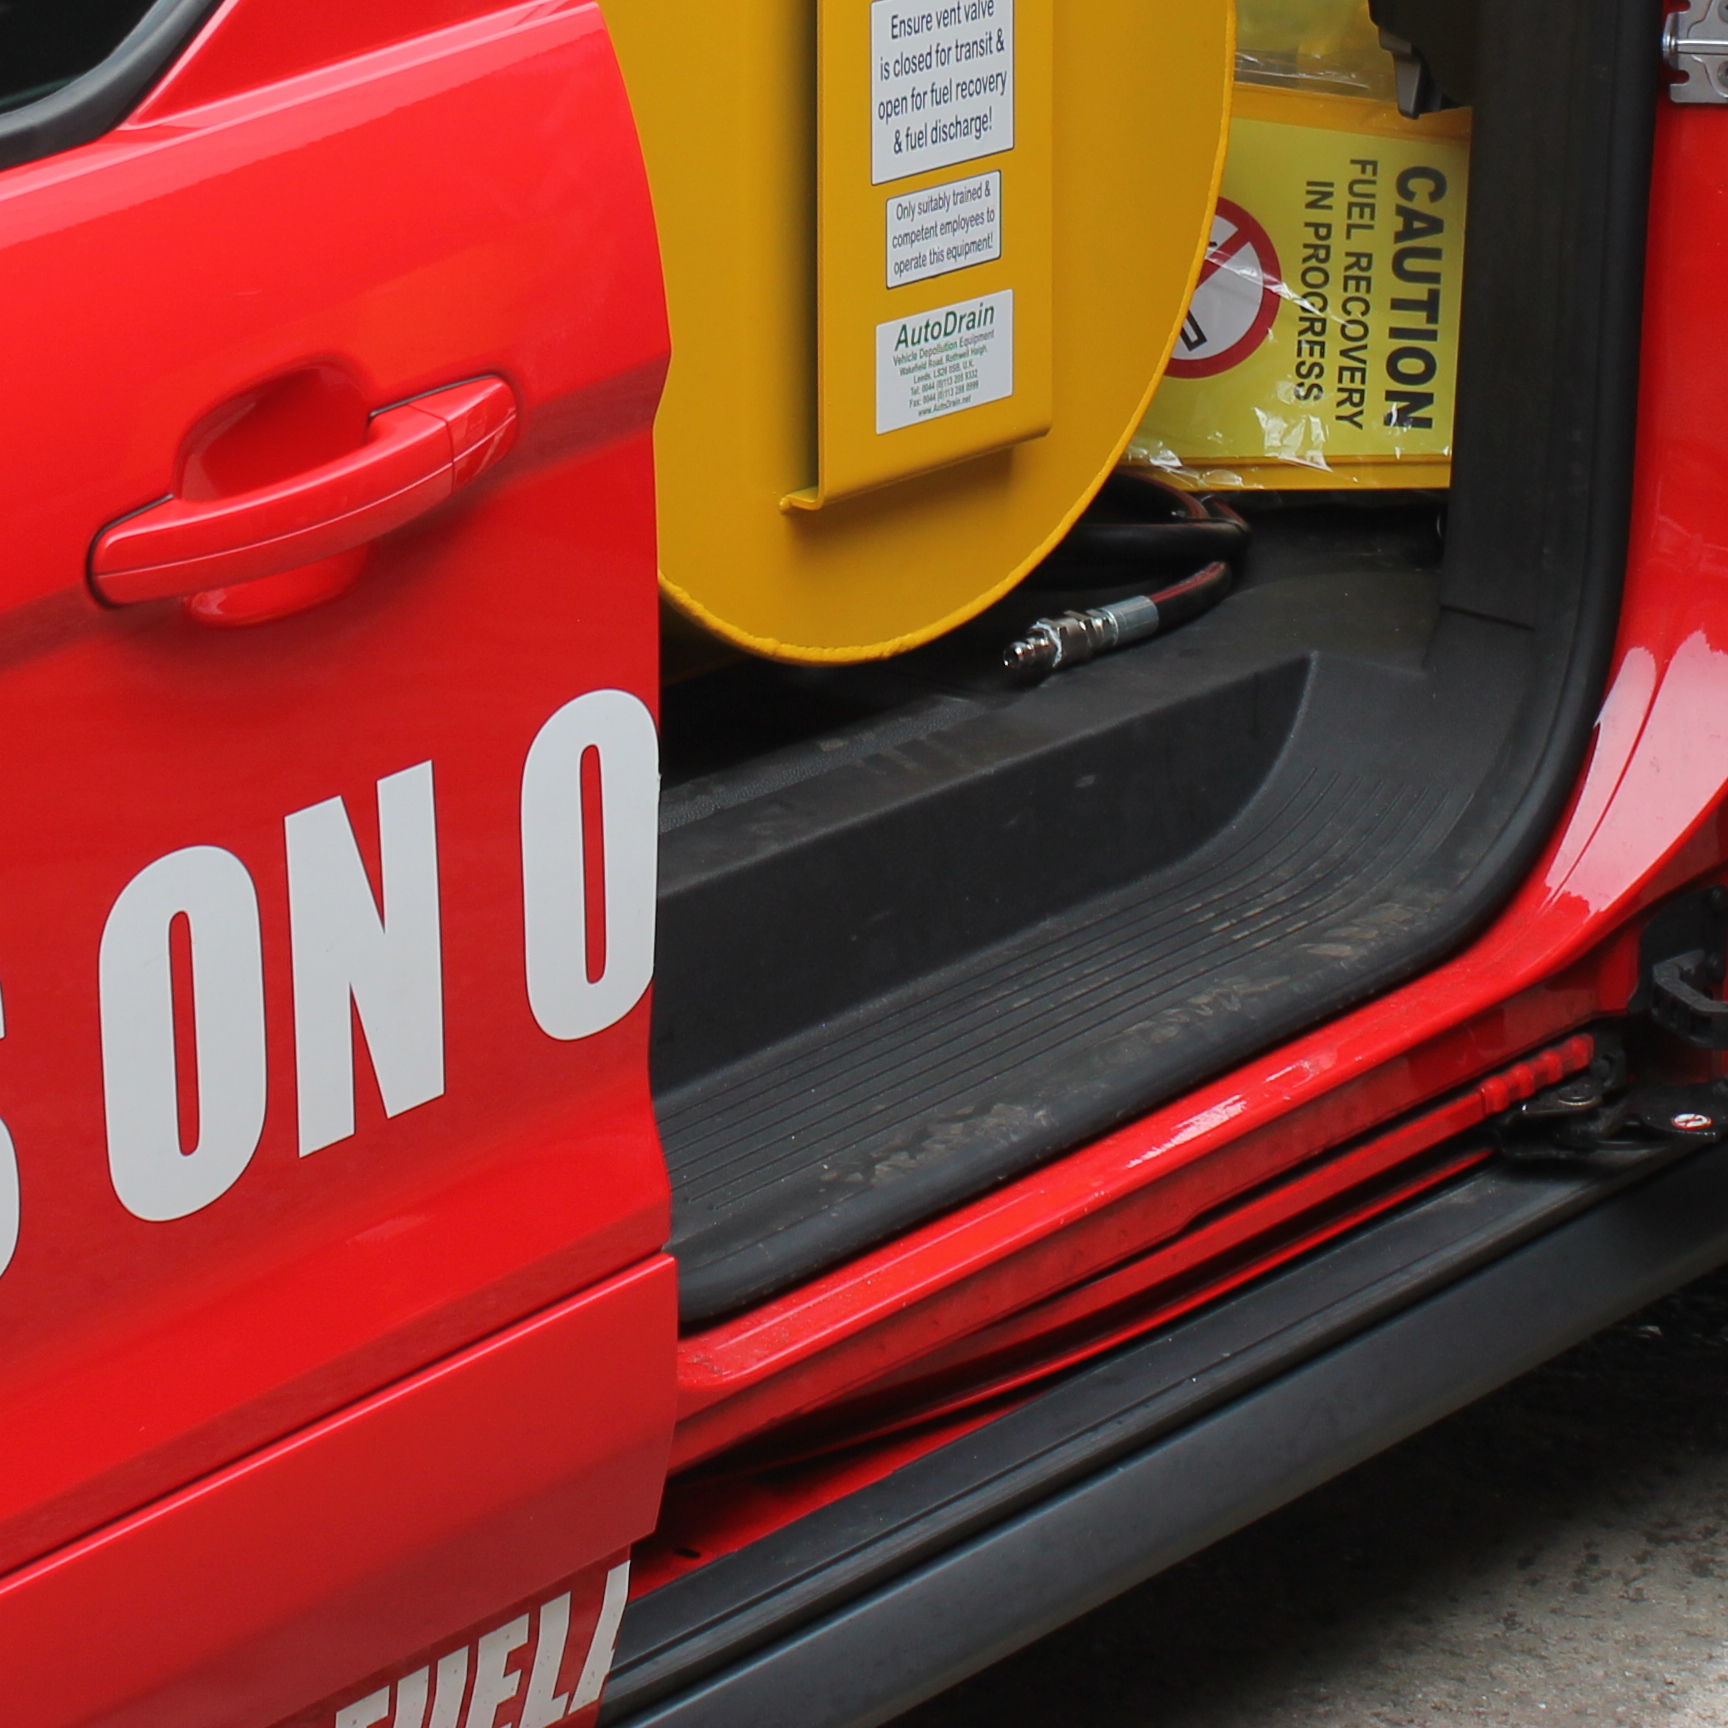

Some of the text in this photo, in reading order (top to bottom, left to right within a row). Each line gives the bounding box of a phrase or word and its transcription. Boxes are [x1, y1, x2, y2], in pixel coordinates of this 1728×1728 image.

[891, 12, 933, 40] Ensure
[936, 0, 962, 29] vent
[880, 28, 1005, 81] is closed for transit &
[878, 70, 1007, 125] open for fuel recovery
[893, 106, 993, 155] & fuel discharge!
[896, 180, 991, 222] Only suitably trained &
[892, 207, 995, 248] competent employees to
[894, 232, 993, 278] operate this equipment!
[1294, 180, 1335, 402] IN PROGRESS
[1335, 159, 1378, 431] FUEL RECOVERY
[1383, 165, 1448, 429] CAUTION
[893, 329, 995, 366] Vehicle Depollution Equipment
[894, 302, 995, 351] AutoDrain
[99, 760, 445, 1222] ON
